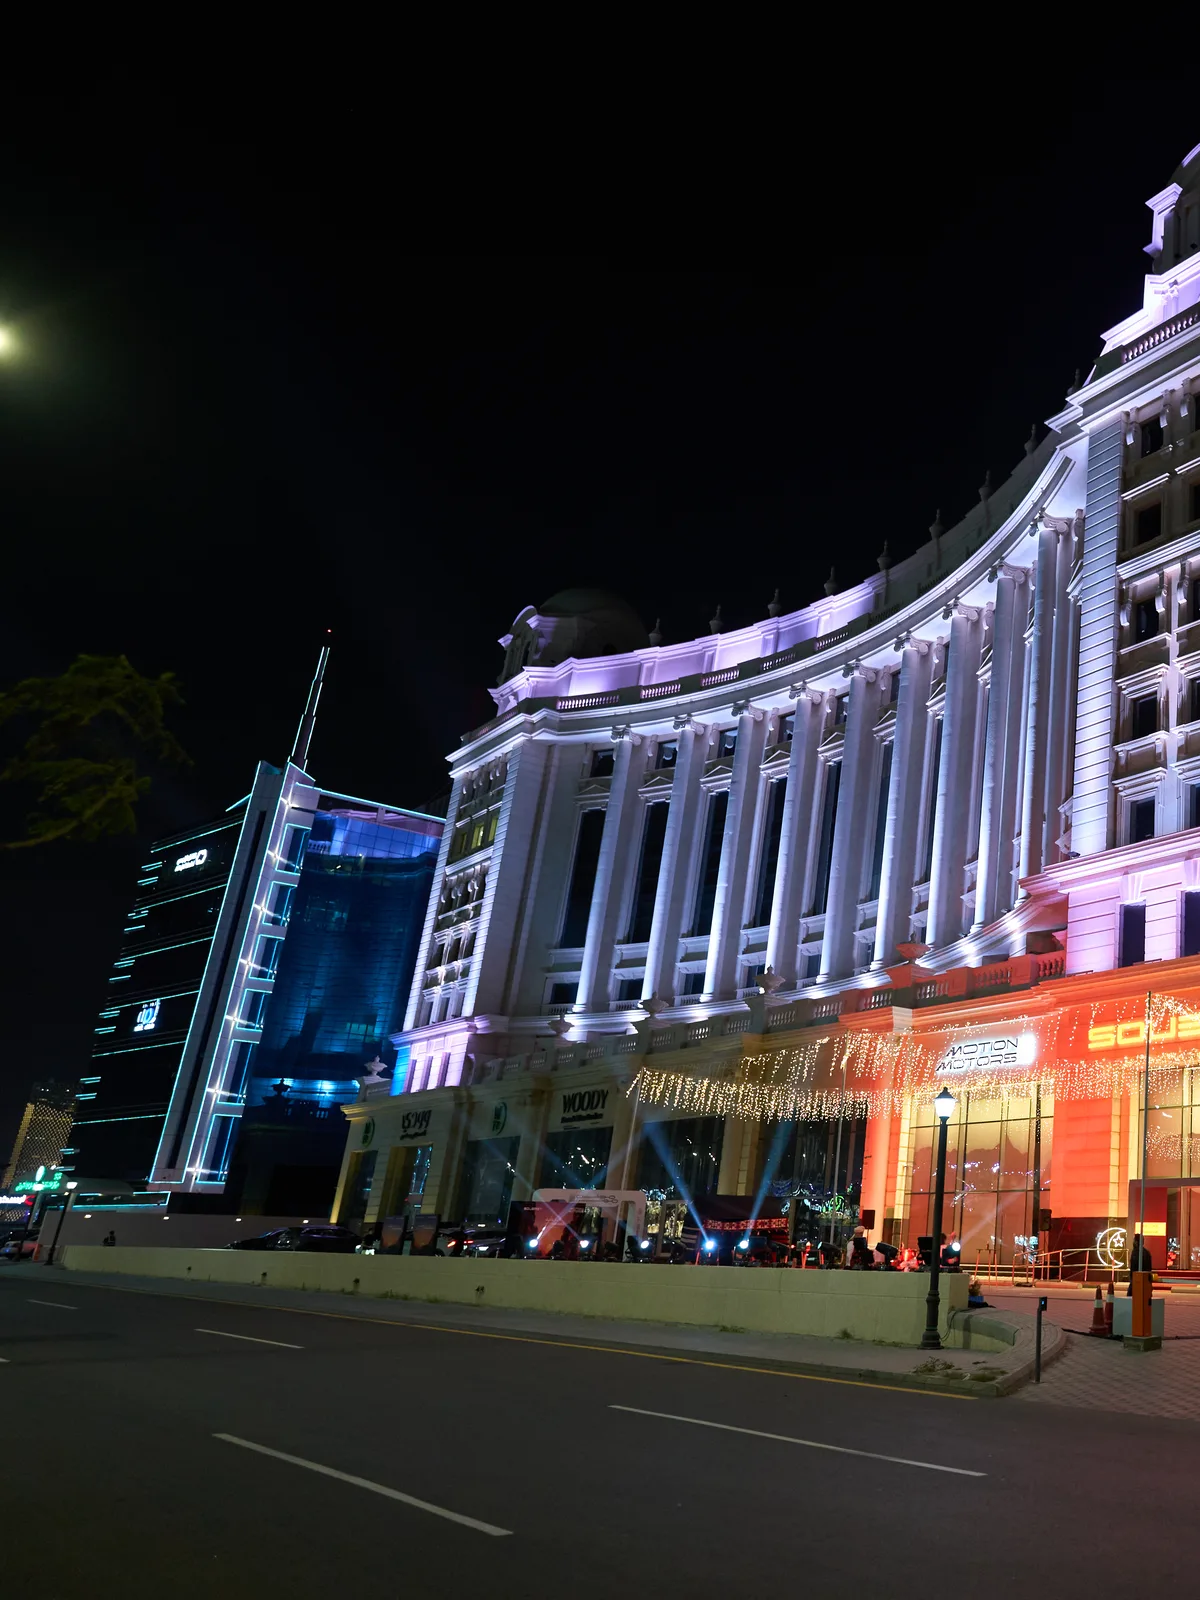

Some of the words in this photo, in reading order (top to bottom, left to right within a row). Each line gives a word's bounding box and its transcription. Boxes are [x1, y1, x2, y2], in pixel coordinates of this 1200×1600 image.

[946, 1038, 1019, 1057] MOTION
[936, 1052, 1017, 1071] MOTORS
[562, 1089, 609, 1114] WOODY
